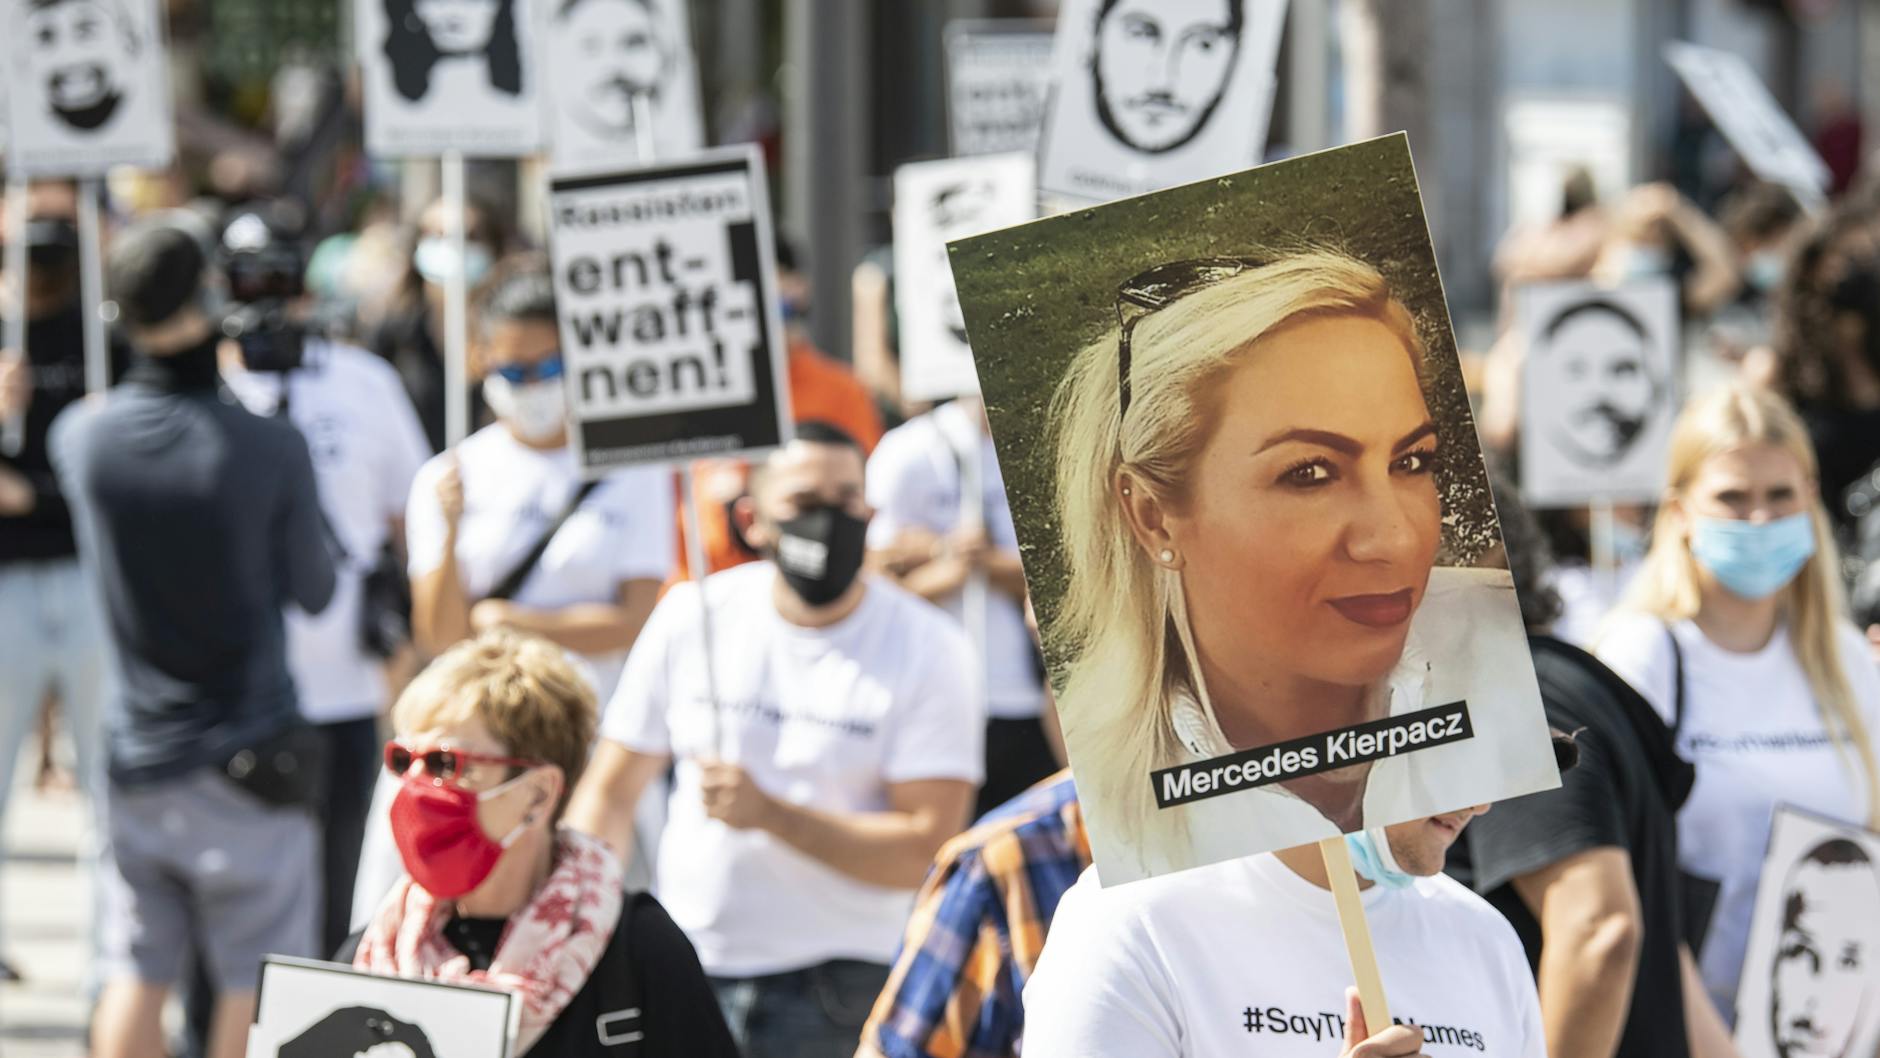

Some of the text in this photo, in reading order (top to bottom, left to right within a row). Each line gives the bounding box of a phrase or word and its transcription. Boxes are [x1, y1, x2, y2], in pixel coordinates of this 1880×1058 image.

[566, 238, 706, 295] ent-
[571, 288, 745, 349] waff-
[581, 344, 732, 403] nen!
[1162, 711, 1464, 801] Mercedes Kierpacz
